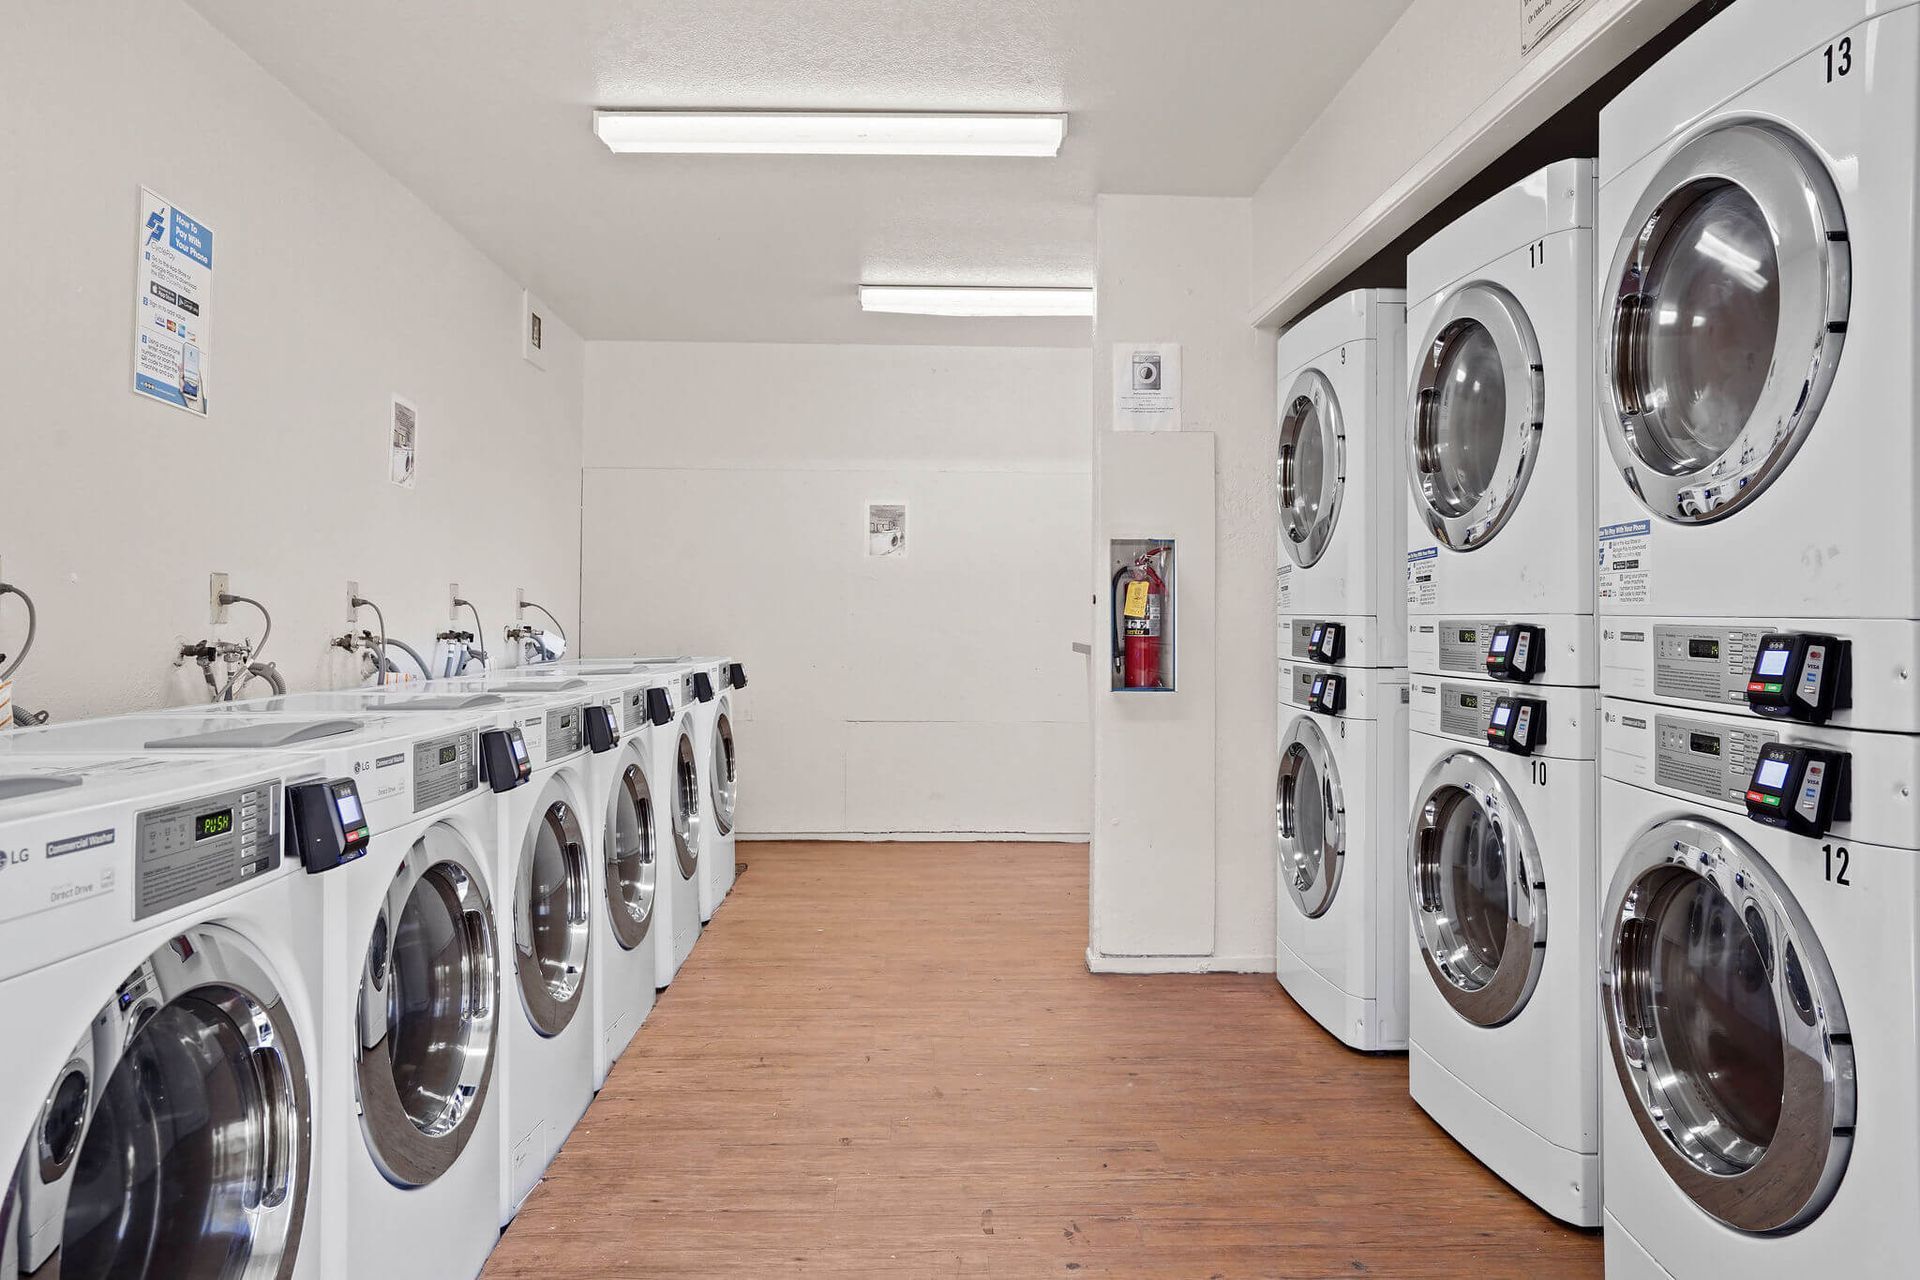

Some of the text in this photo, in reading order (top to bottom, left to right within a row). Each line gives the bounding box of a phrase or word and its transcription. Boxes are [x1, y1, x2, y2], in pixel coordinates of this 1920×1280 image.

[1824, 36, 1851, 83] 13
[176, 213, 198, 235] How To
[175, 225, 202, 250] Pay With
[175, 237, 208, 265] Your Phone
[1530, 239, 1543, 268] 11
[1341, 347, 1345, 365] 9
[1608, 631, 1614, 639] LG
[1341, 720, 1345, 738] 8
[362, 761, 370, 771] LG
[1531, 760, 1546, 786] 10
[204, 815, 229, 833] PUSH
[48, 834, 113, 856] Commercial Washer
[11, 848, 29, 865] LG
[1822, 844, 1850, 886] 12
[51, 884, 93, 902] Direct Drive
